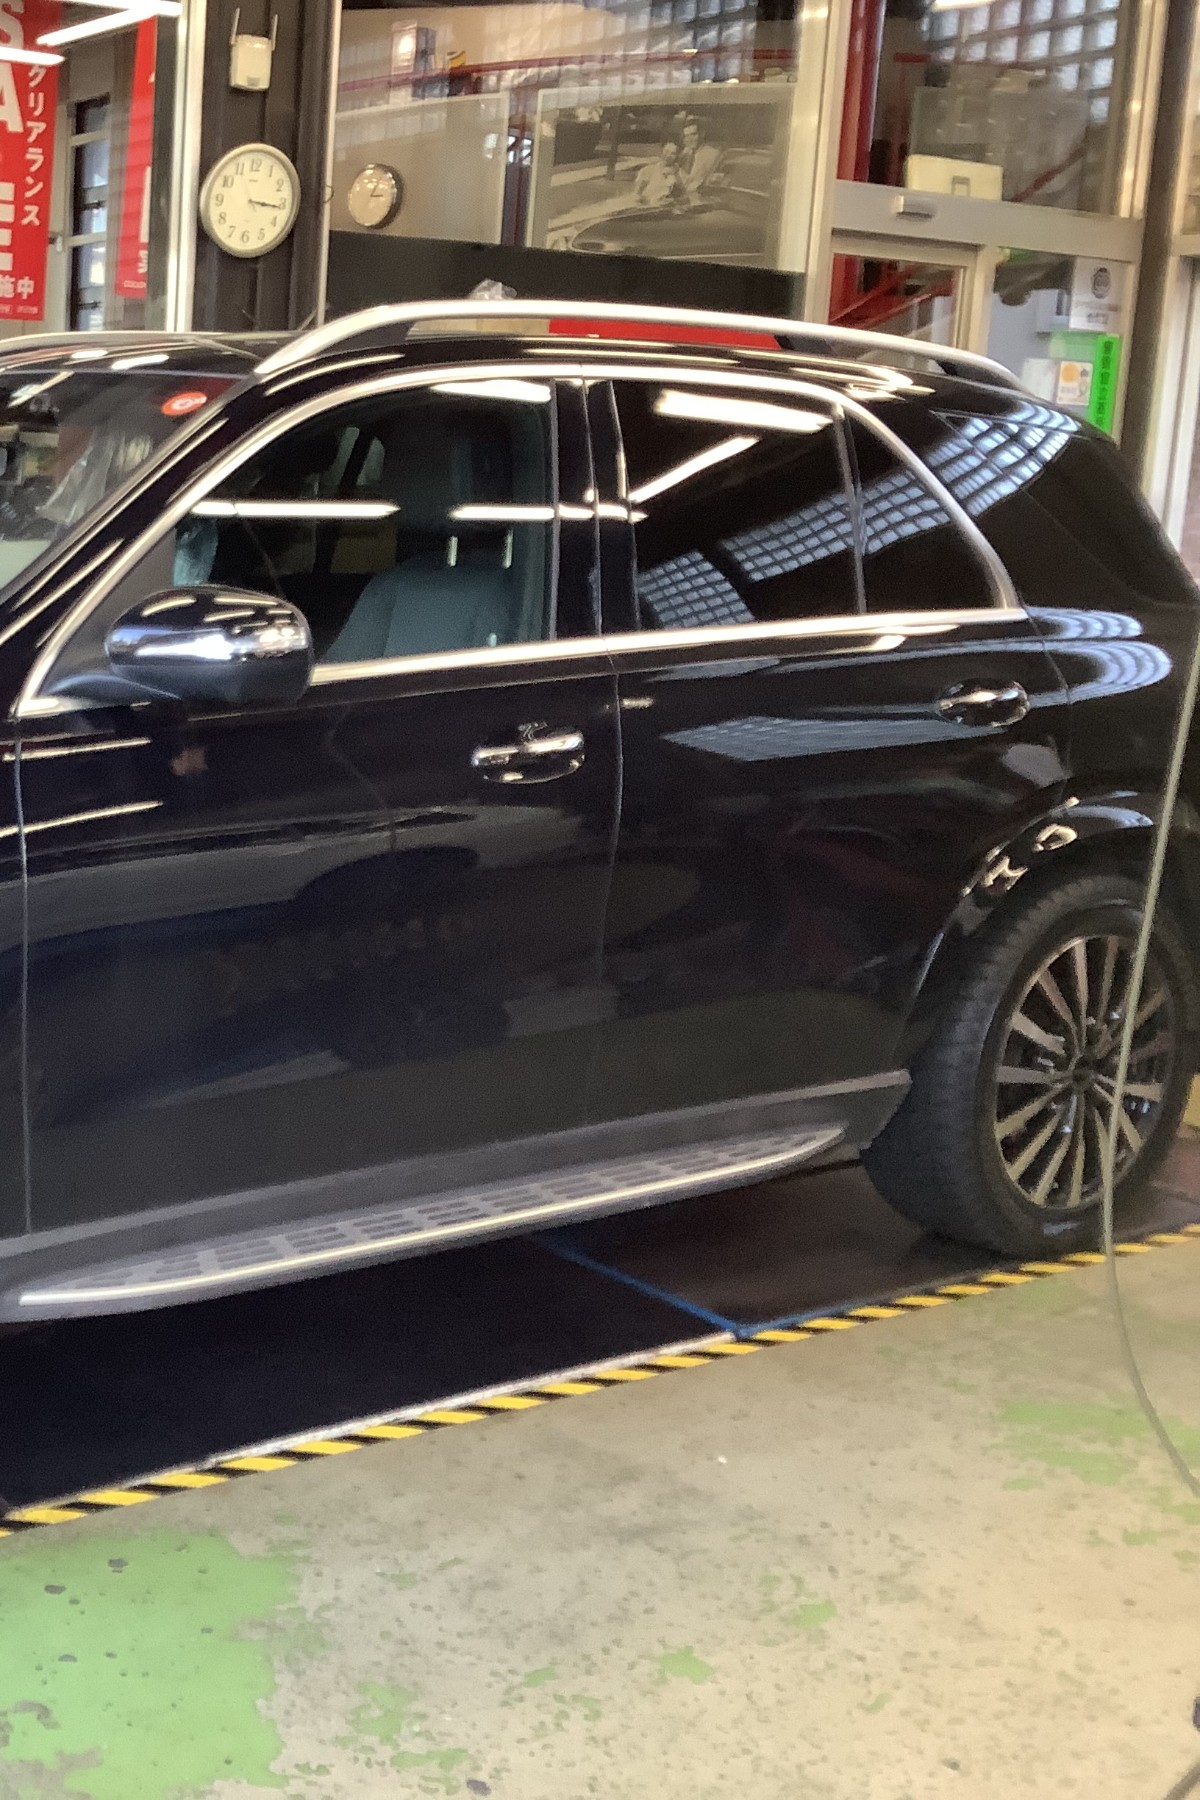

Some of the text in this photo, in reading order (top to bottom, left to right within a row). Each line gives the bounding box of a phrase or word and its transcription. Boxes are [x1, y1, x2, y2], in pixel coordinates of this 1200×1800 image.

[21, 62, 47, 226] クリアランス
[241, 230, 250, 243] 6
